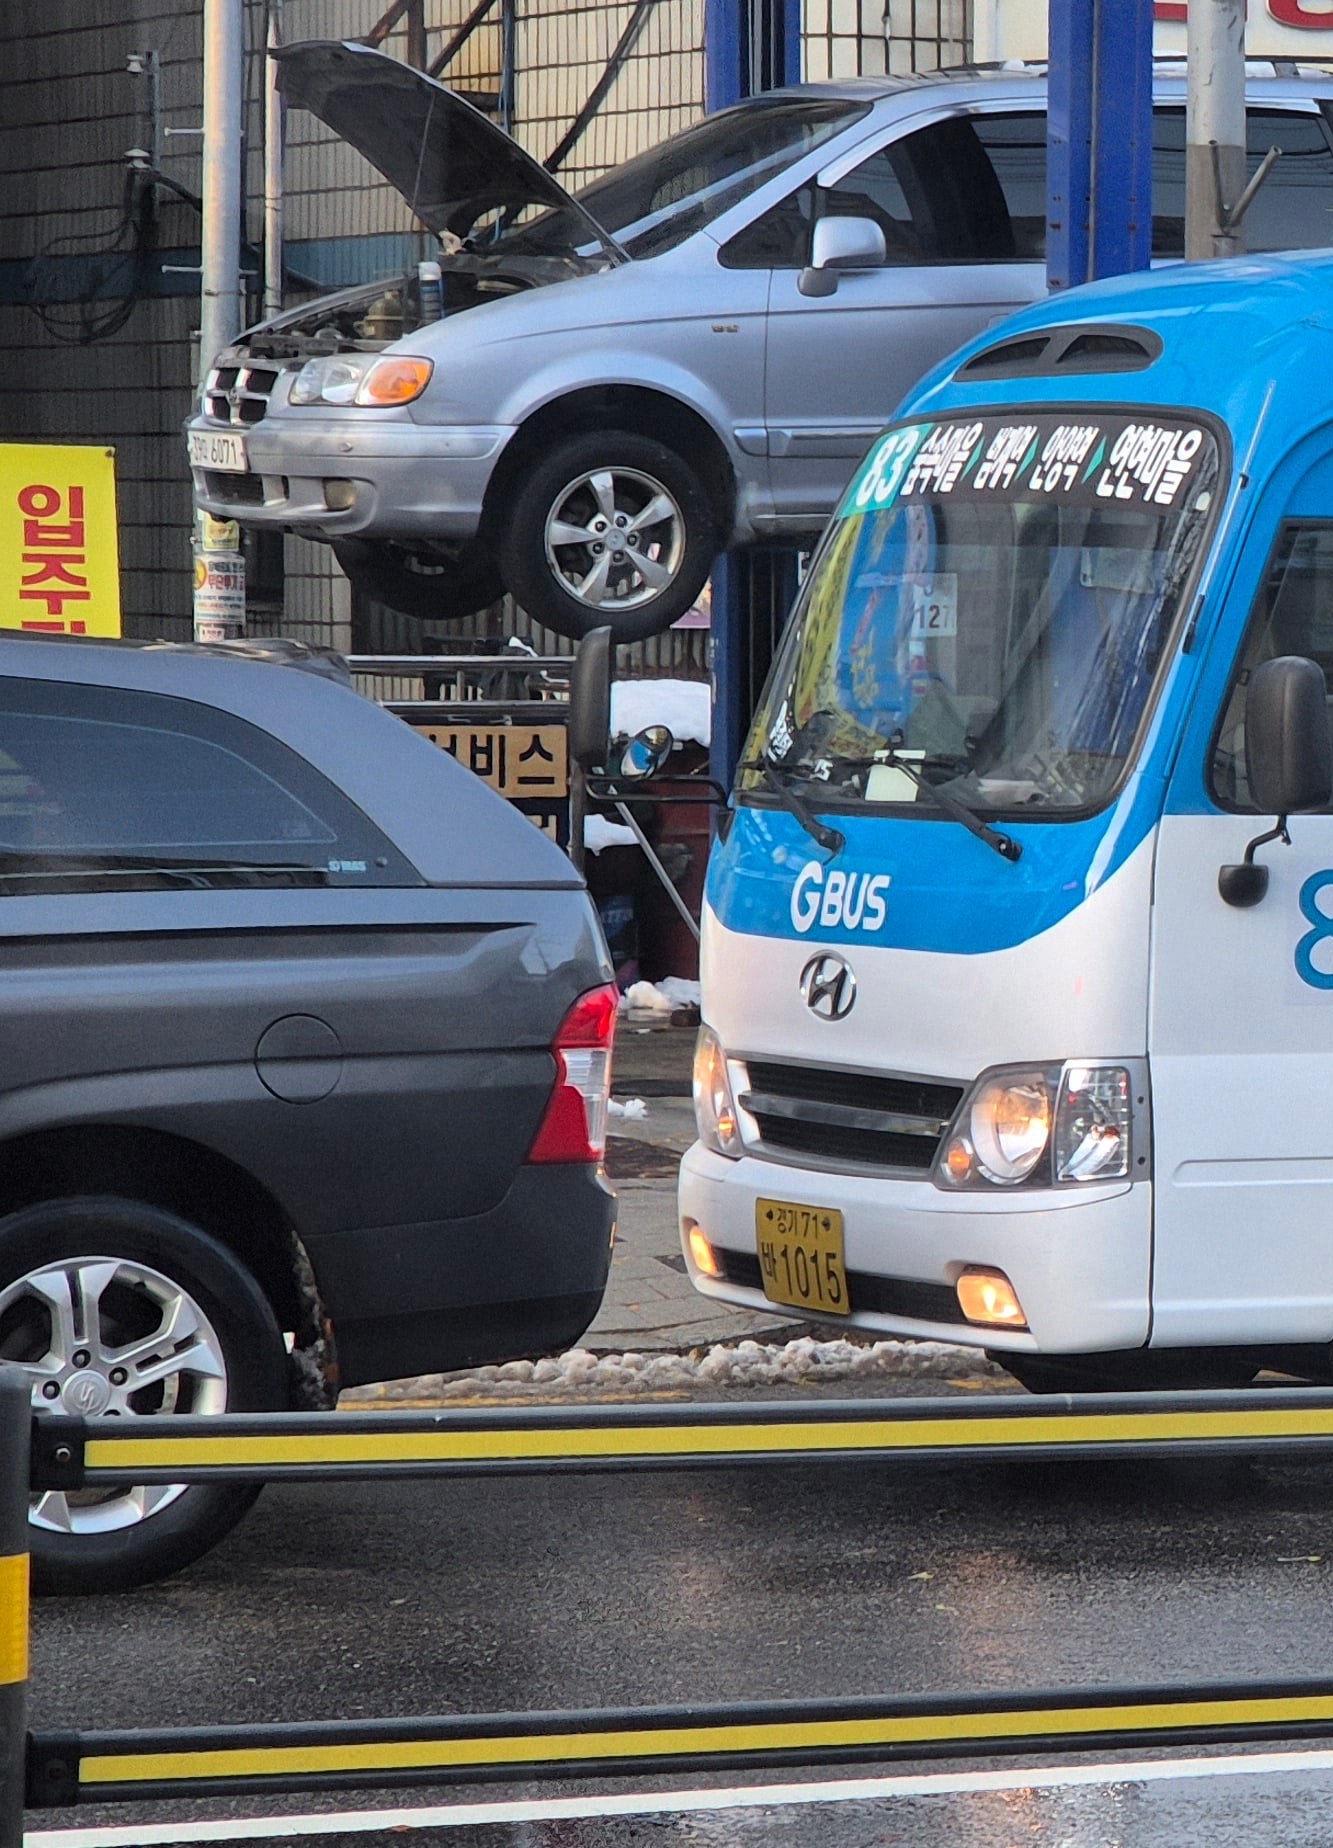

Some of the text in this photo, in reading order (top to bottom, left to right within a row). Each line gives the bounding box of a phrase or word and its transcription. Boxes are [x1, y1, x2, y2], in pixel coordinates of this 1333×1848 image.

[856, 430, 920, 507] 83
[1029, 425, 1100, 493] 안양역
[1096, 423, 1203, 506] 연현마을
